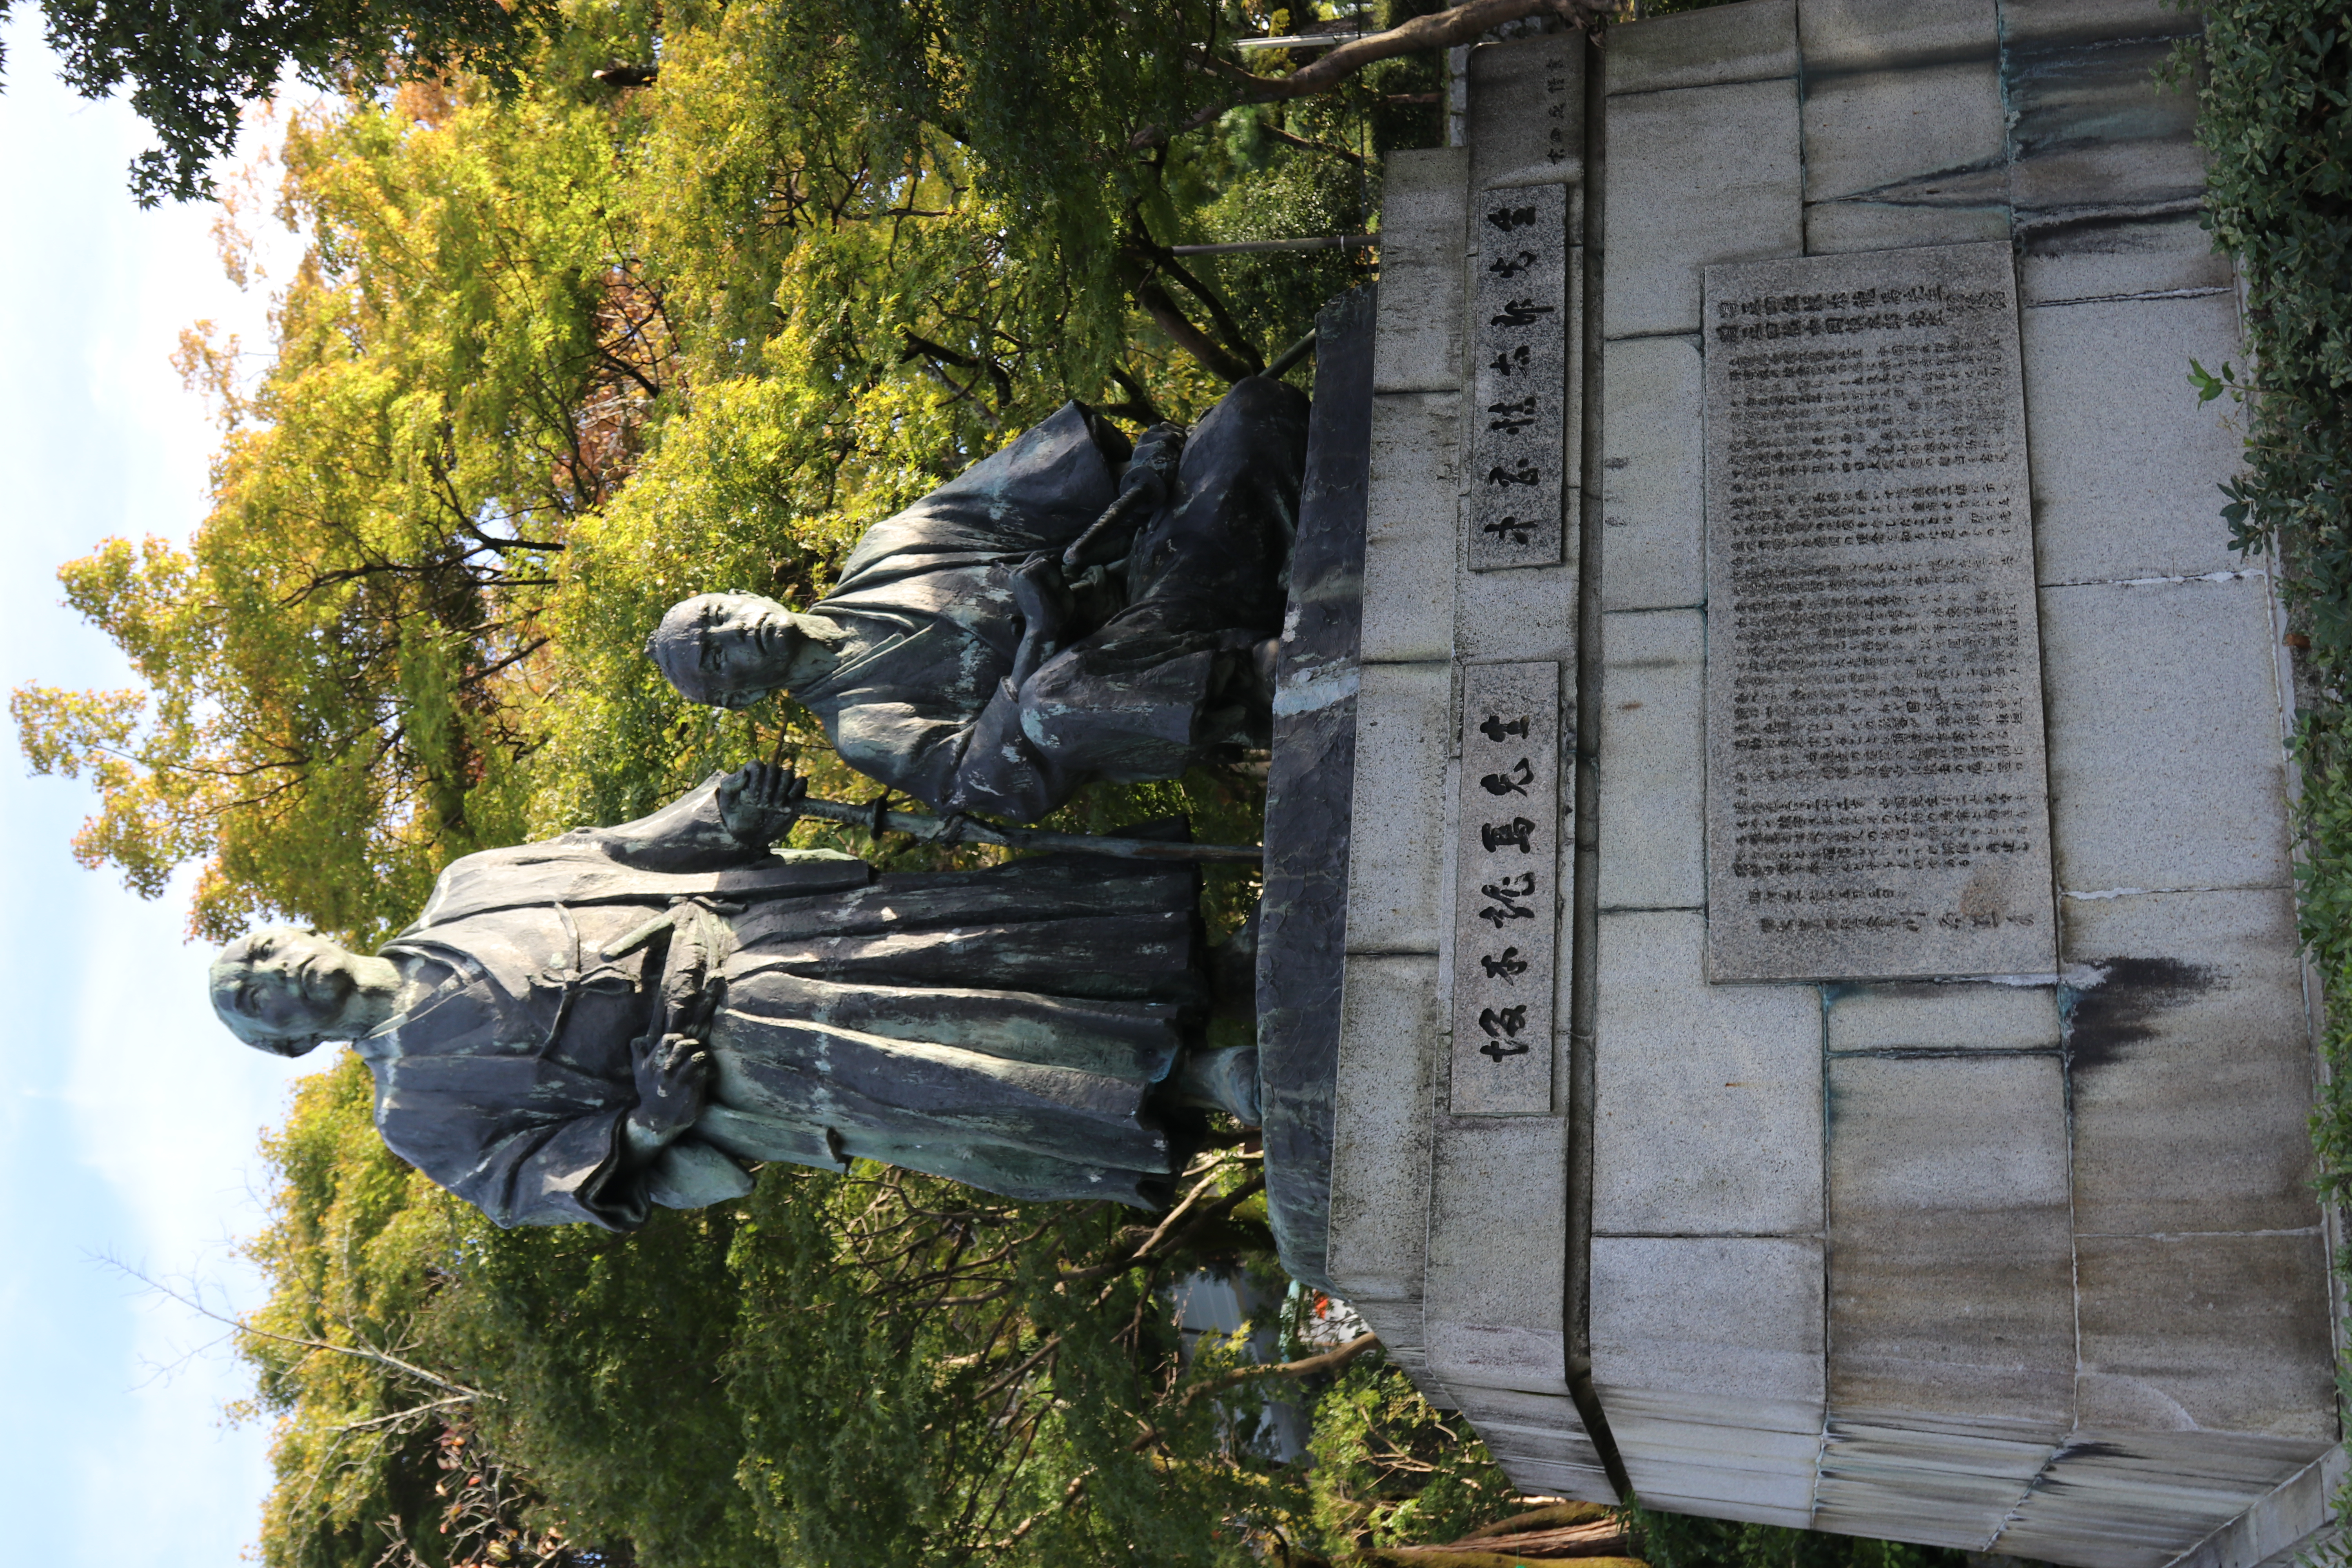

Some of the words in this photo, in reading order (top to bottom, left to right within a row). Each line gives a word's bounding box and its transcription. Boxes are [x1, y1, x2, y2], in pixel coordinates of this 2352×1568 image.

[1484, 207, 1554, 545] 中岡慎太郎先生
[1478, 715, 1535, 1063] 坂本龍馬先生
